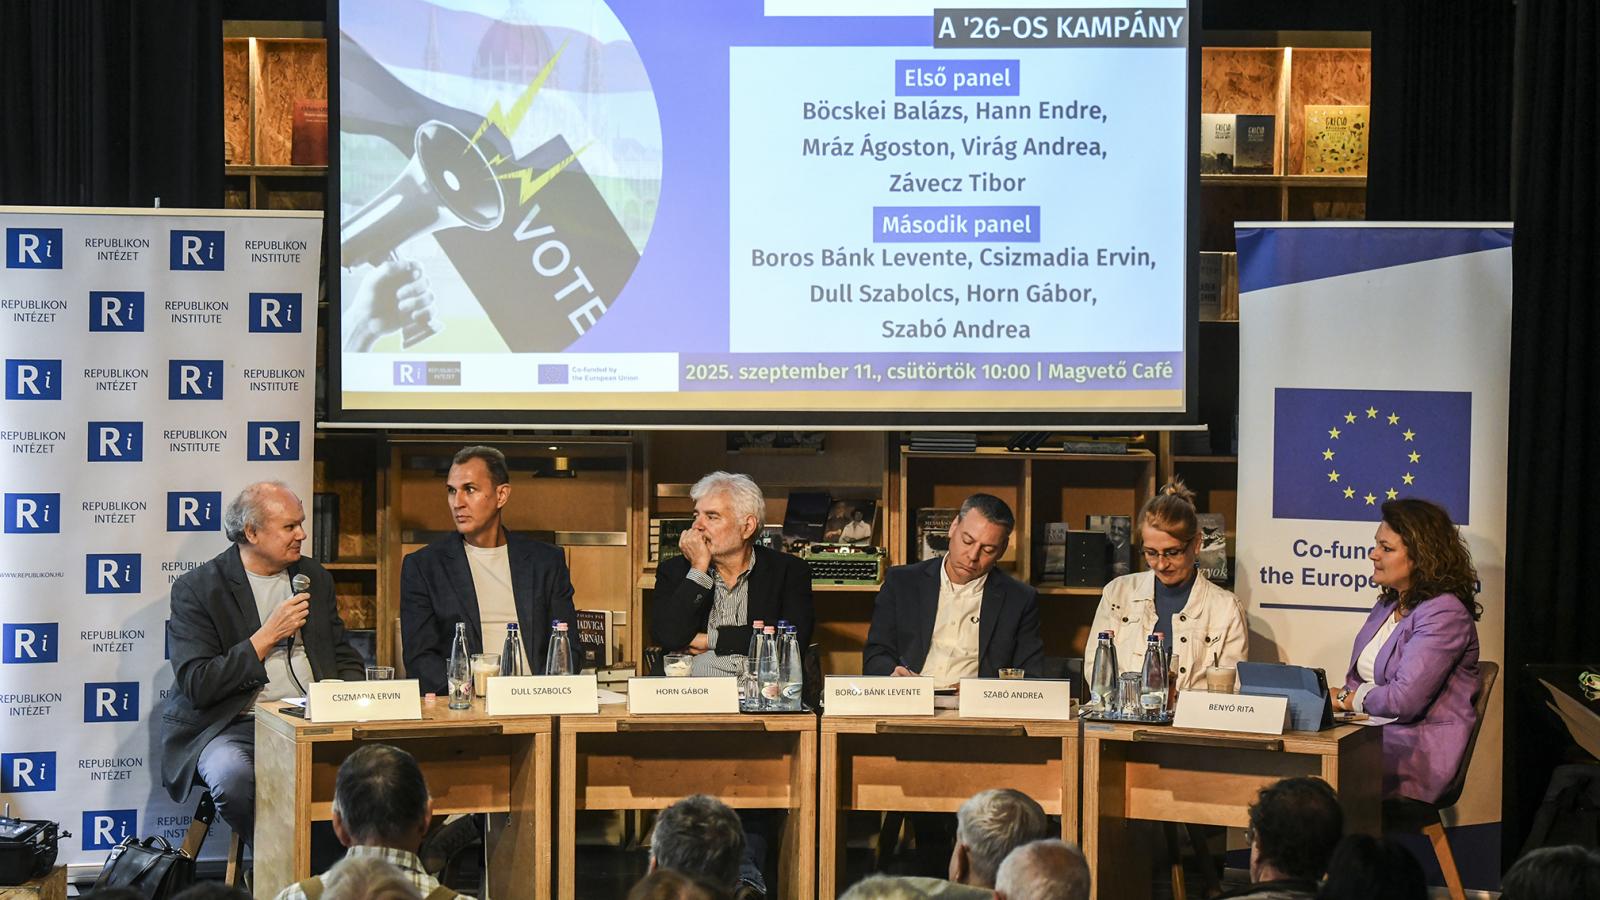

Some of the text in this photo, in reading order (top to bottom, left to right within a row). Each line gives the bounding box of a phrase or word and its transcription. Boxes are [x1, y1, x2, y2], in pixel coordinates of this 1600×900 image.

[939, 10, 1183, 38] A '26-OS KAMPÁNY
[906, 66, 1010, 91] Első panel
[804, 100, 1107, 123] Böcskei Balázs, Hann Endre,
[803, 133, 1106, 161] Mráz Ágoston, Virág Andrea,
[890, 172, 1026, 192] Závecz Tibor
[883, 214, 1031, 237] Második panel
[86, 238, 149, 248] REPUBLIKON
[246, 241, 306, 250] REPUBLIKON
[98, 250, 138, 260] INTÉZET
[252, 254, 300, 263] INSTITUTE
[752, 246, 1155, 270] Boros Bánk Levente, Csizmadia Ervin,
[513, 203, 607, 336] VOTE
[811, 283, 1096, 306] Dull Szabolcs, Horn Gábor,
[2, 300, 67, 309] REPUBLIKON
[165, 301, 228, 310] REPUBLIKON
[14, 311, 56, 322] INTÉZET
[172, 314, 221, 323] INSTITUTE
[882, 318, 1030, 338] Szabó Andrea
[85, 369, 148, 378] REPUBLIKON
[244, 369, 304, 378] REPUBLIKON
[686, 365, 733, 379] 2025.
[739, 363, 848, 383] szeptember
[854, 364, 881, 382] 11.,
[888, 362, 976, 379] csütörtök
[982, 364, 1030, 379] 10:00
[1049, 361, 1126, 382] Magvető
[1133, 361, 1172, 378] Café
[97, 380, 137, 390] INTÉZET
[251, 382, 298, 391] INSTITUTE
[1, 432, 65, 440] REPUBLIKON
[164, 430, 227, 439] REPUBLIKON
[13, 443, 54, 453] INTÉZET
[170, 443, 220, 452] INSTITUTE
[83, 502, 146, 511] REPUBLIKON
[95, 513, 135, 523] INTÉZET
[161, 562, 206, 570] REPUBL
[1260, 566, 1294, 585] the
[81, 630, 144, 640] REPUBLIKON
[93, 642, 133, 652] INTÉZET
[0, 693, 62, 703] REPUBLIKON
[984, 690, 1009, 698] SZABÓ
[10, 705, 51, 715] INTÉZET
[79, 758, 142, 768] REPUBLIKON
[91, 770, 132, 780] INTÉZET
[157, 815, 220, 826] REPUBLN
